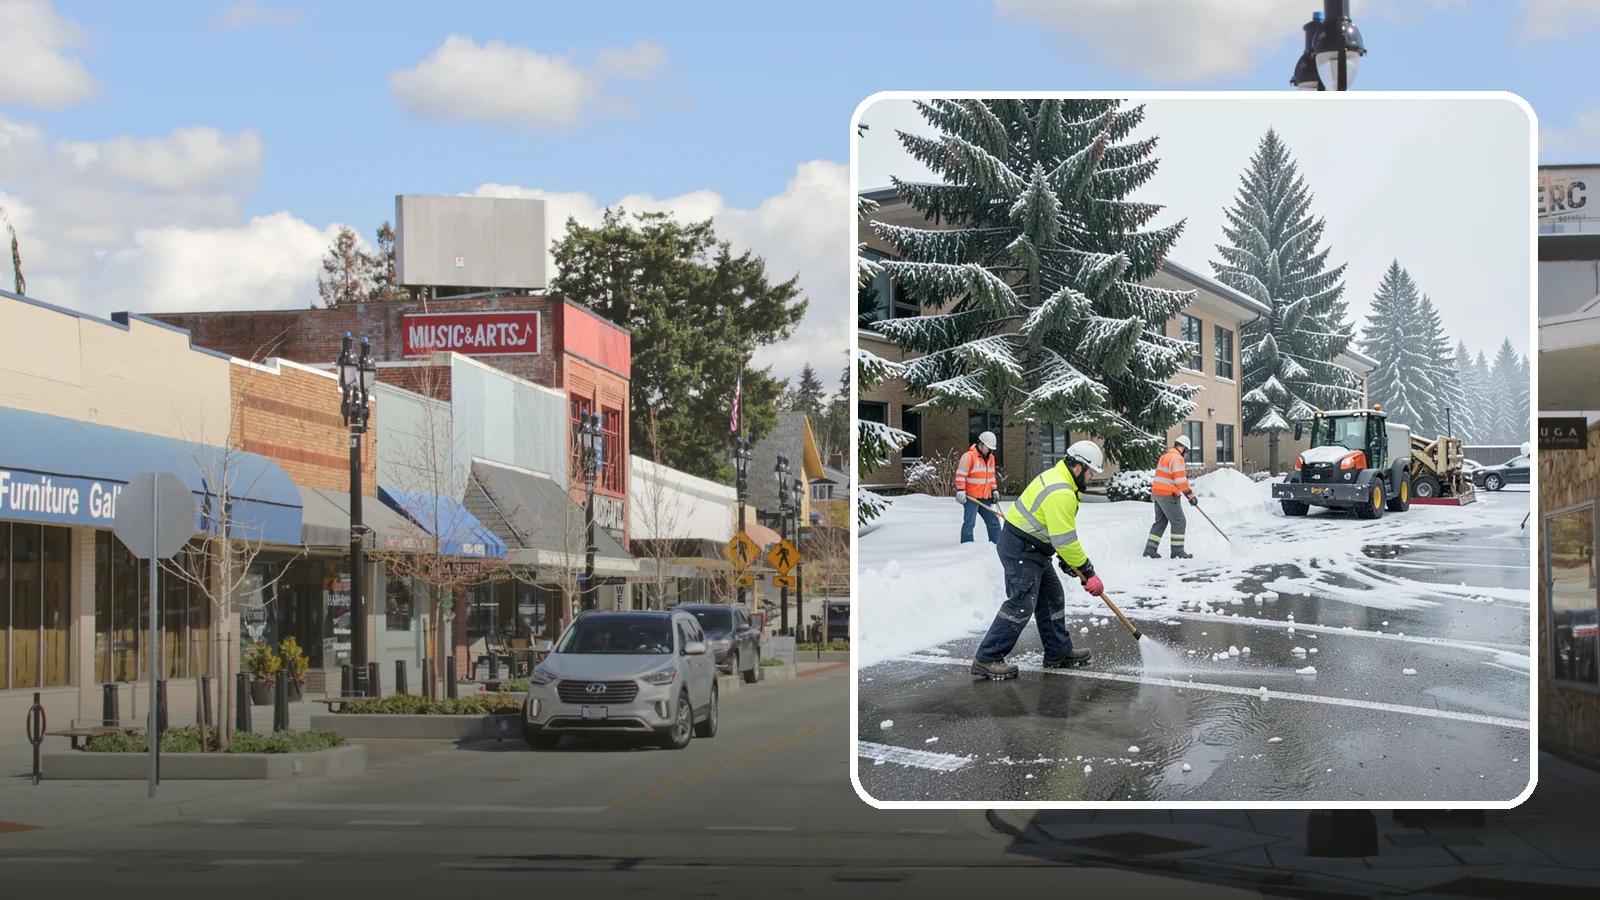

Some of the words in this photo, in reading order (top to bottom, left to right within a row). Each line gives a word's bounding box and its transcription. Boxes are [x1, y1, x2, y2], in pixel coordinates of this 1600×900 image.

[1541, 428, 1577, 437] UGA
[0, 471, 79, 515] Furniture
[89, 482, 122, 519] Gal
[453, 563, 479, 574] SUSHI
